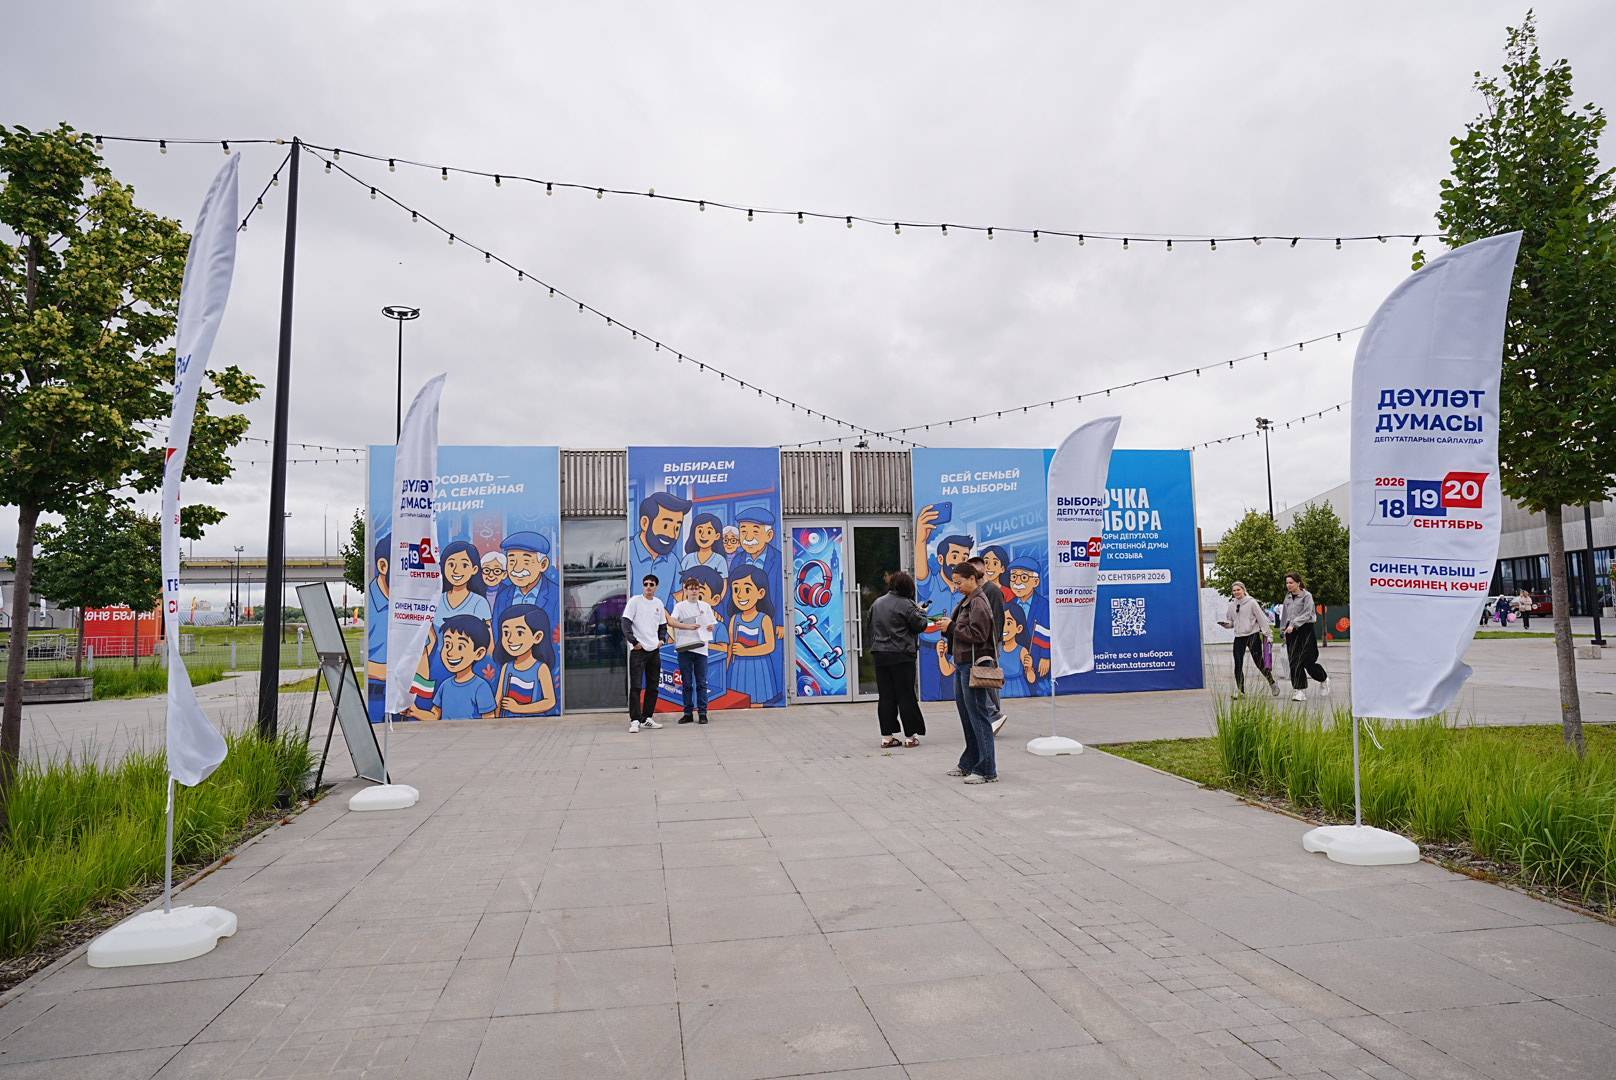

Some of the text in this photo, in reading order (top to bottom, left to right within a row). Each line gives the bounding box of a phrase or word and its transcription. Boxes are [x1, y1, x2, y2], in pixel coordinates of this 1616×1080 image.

[1378, 388, 1485, 410] ДӘҮЛӘТ
[1376, 414, 1482, 432] ДУМАСЫ
[1436, 437, 1484, 445] САЙЛАУЛАР
[664, 460, 734, 472] ВЫБИРАЕМ
[664, 474, 728, 486] БУДУЩЕЕ!
[941, 468, 1020, 483] ВСЕЙ СЕМЬЕЙ
[1375, 478, 1405, 486] 2026
[451, 483, 524, 497] СЕМЕЙНАЯ
[942, 482, 1016, 495] НА ВЫБОРЫ!
[1445, 480, 1479, 500] 20
[1411, 489, 1439, 509] 19
[434, 500, 484, 513] ДИЦИЯ!
[1379, 499, 1405, 518] 18
[987, 508, 1044, 536] УЧАСТОК
[1414, 519, 1483, 530] СЕНТЯБРЬ
[1072, 546, 1086, 557] 19
[1148, 542, 1168, 550] ДУМЫ
[410, 550, 419, 564] 19
[1058, 552, 1070, 563] 18
[1370, 563, 1418, 576] СИНЕҢ
[1421, 565, 1475, 577] ТАВЫШ
[1370, 578, 1488, 591] РОССИЯНЕҢ КӨЧЕ!
[1140, 650, 1173, 659] выборах
[1096, 661, 1175, 670] izbirkom.tatarstan.ru
[664, 674, 673, 683] 19
